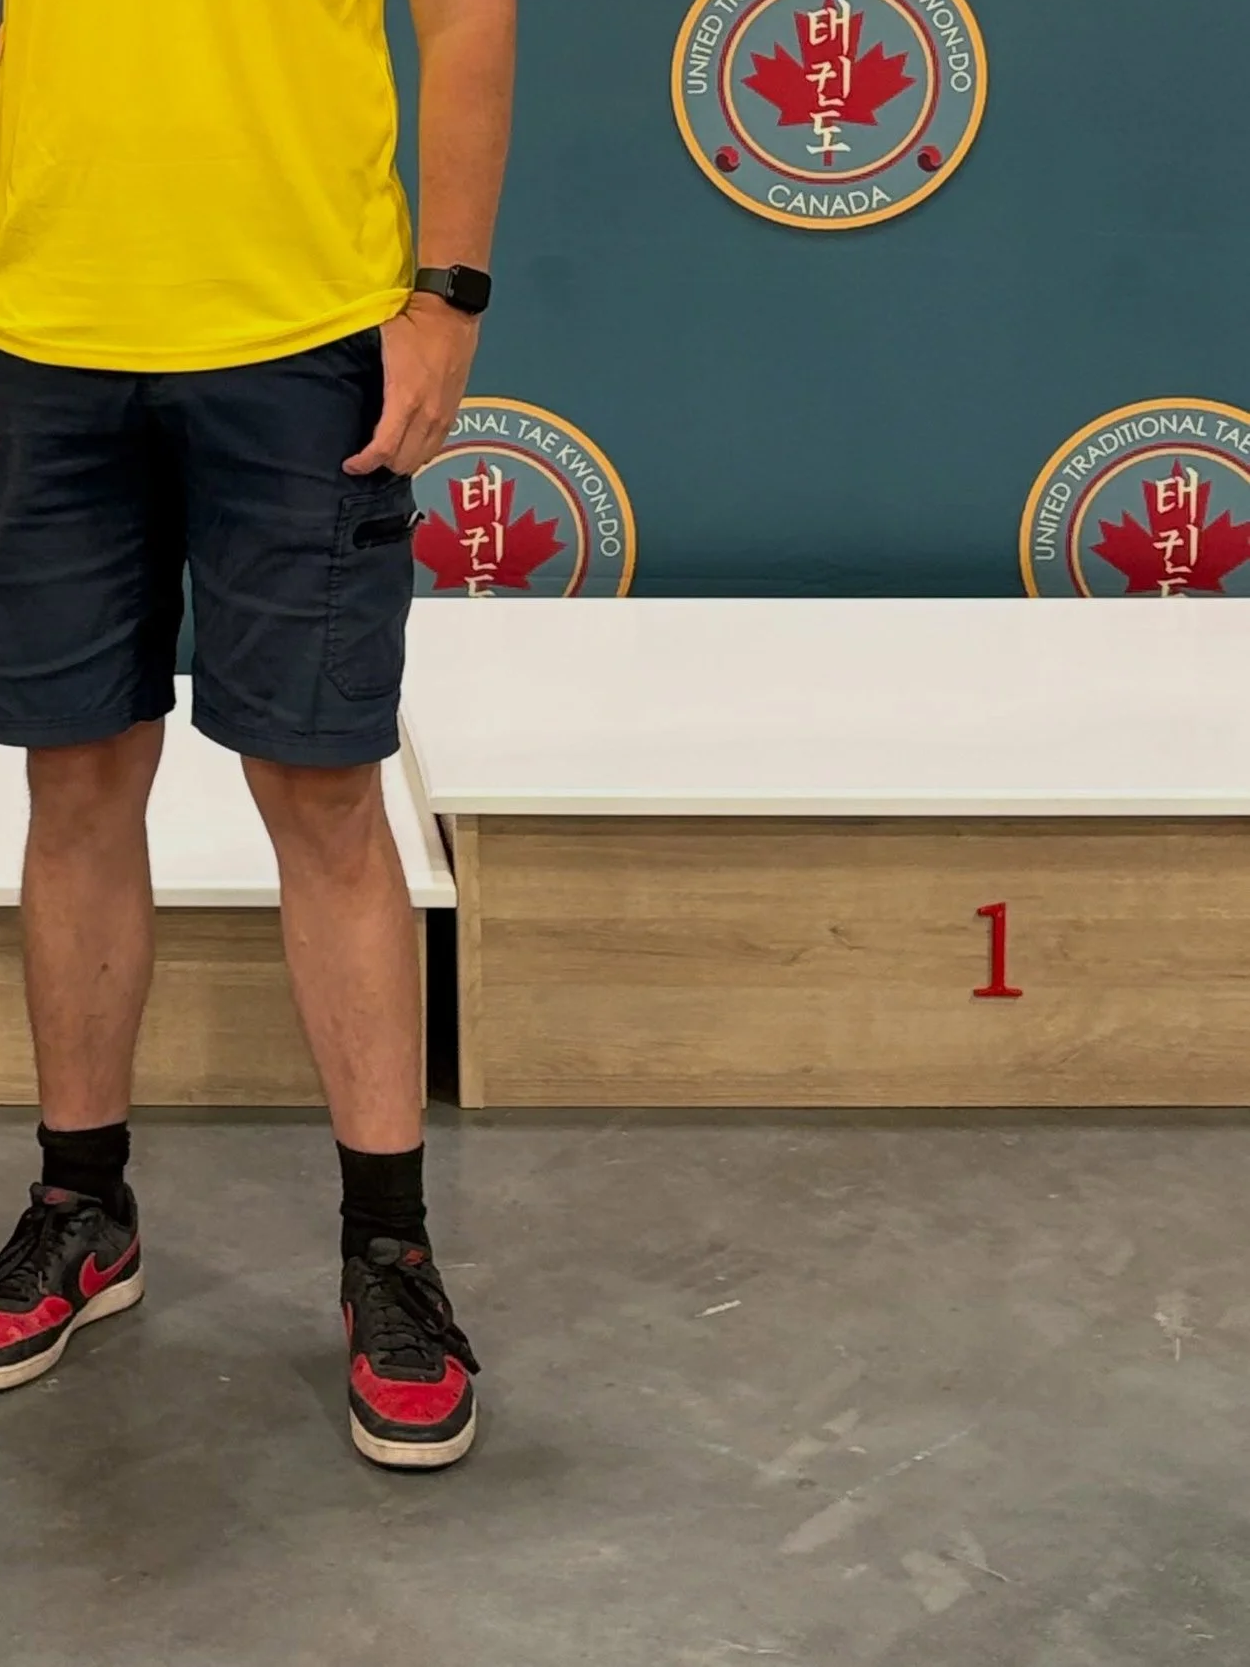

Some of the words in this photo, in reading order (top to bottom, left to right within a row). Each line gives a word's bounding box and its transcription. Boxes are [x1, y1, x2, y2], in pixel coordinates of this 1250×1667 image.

[687, 14, 724, 95] UNITED
[767, 184, 892, 217] CANADA
[518, 419, 560, 453] TAE
[556, 444, 621, 557] KWON-DO
[1035, 482, 1072, 562] UNITED
[1062, 414, 1207, 481] TRADITIONAL
[1215, 419, 1250, 454] TAE
[973, 902, 1022, 998] 1
